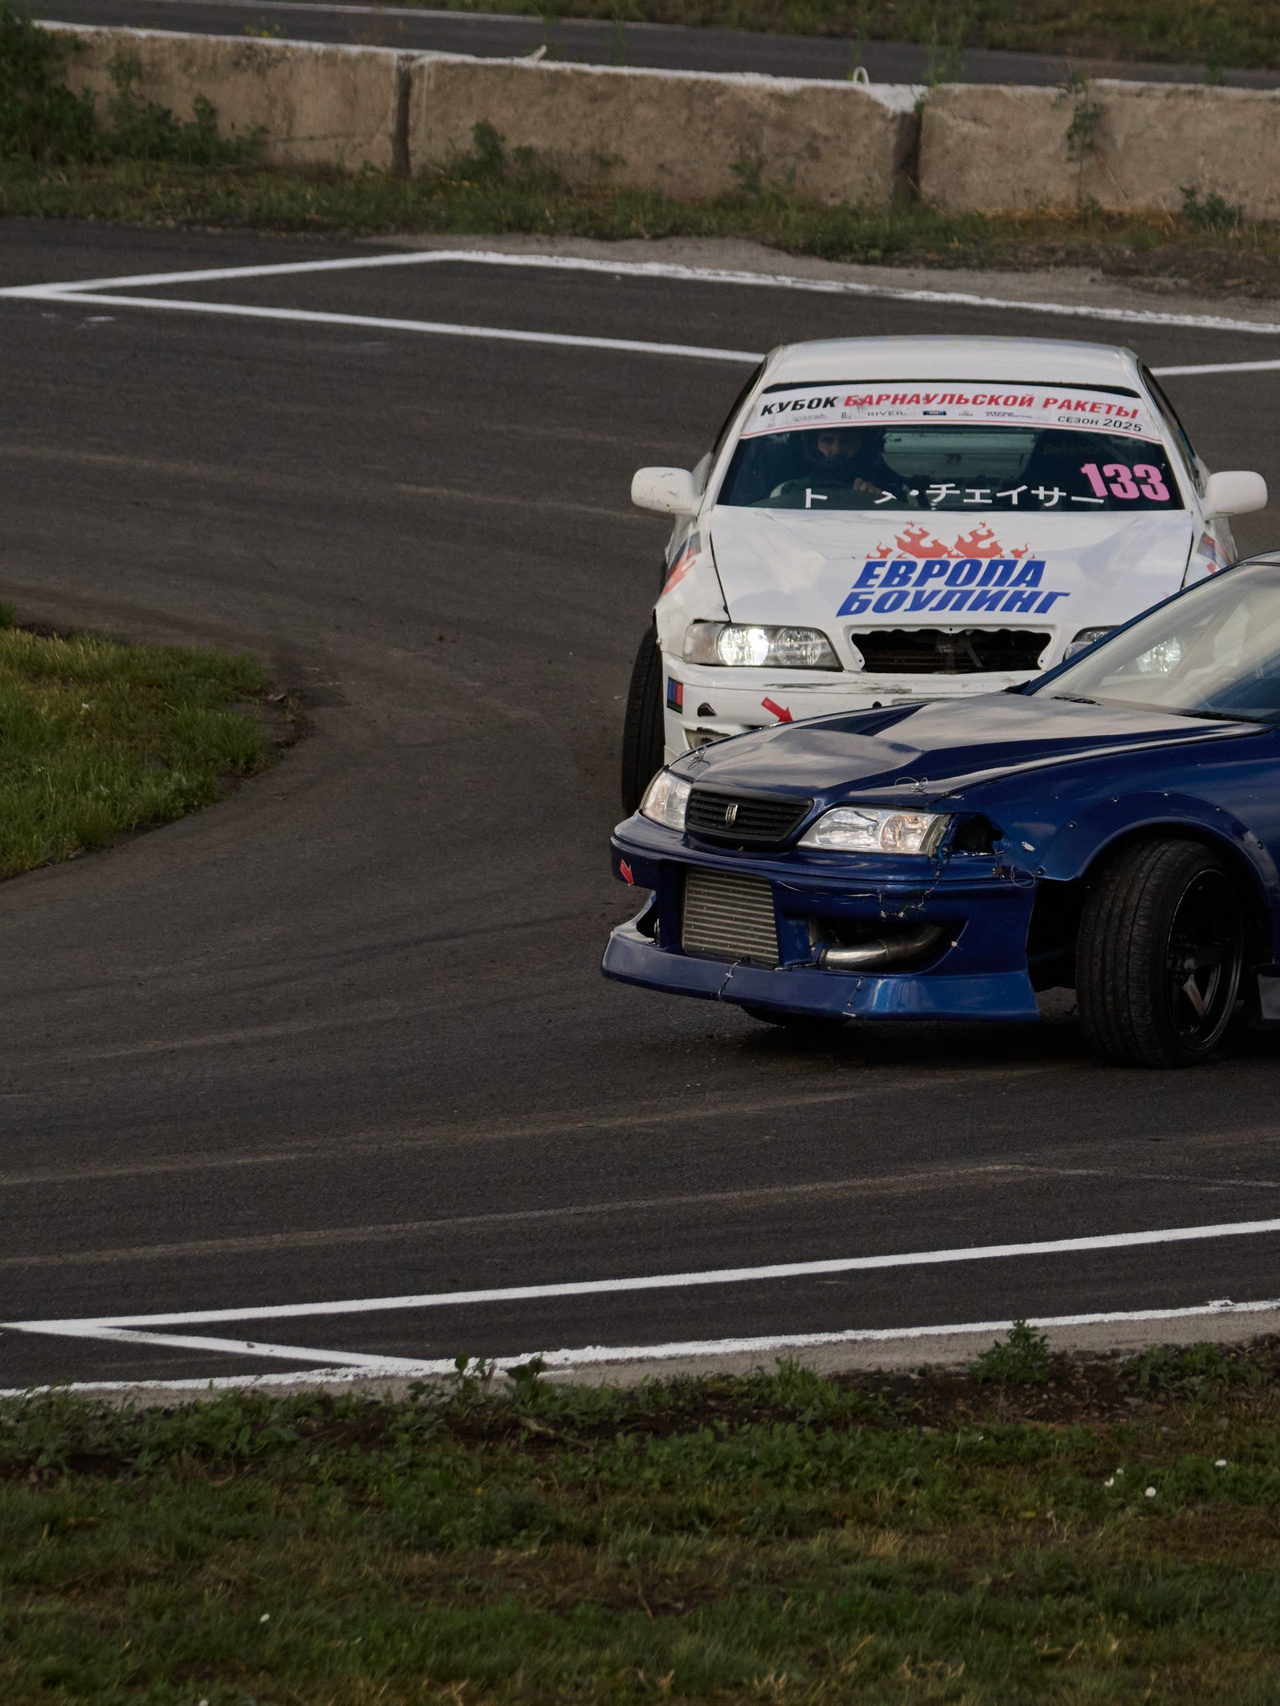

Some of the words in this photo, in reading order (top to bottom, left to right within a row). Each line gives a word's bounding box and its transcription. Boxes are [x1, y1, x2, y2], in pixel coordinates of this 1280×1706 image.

[760, 395, 840, 417] КУБОК
[843, 392, 1035, 408] БАРНАУЛЬСКОЙ
[1041, 396, 1140, 419] РАКЕТЫ
[1057, 415, 1100, 426] СЕЗОН
[1102, 417, 1143, 432] 2025
[1080, 462, 1171, 503] 133
[851, 558, 1047, 589] ЕВРОПА
[836, 588, 1071, 618] БОУЛИНГ
